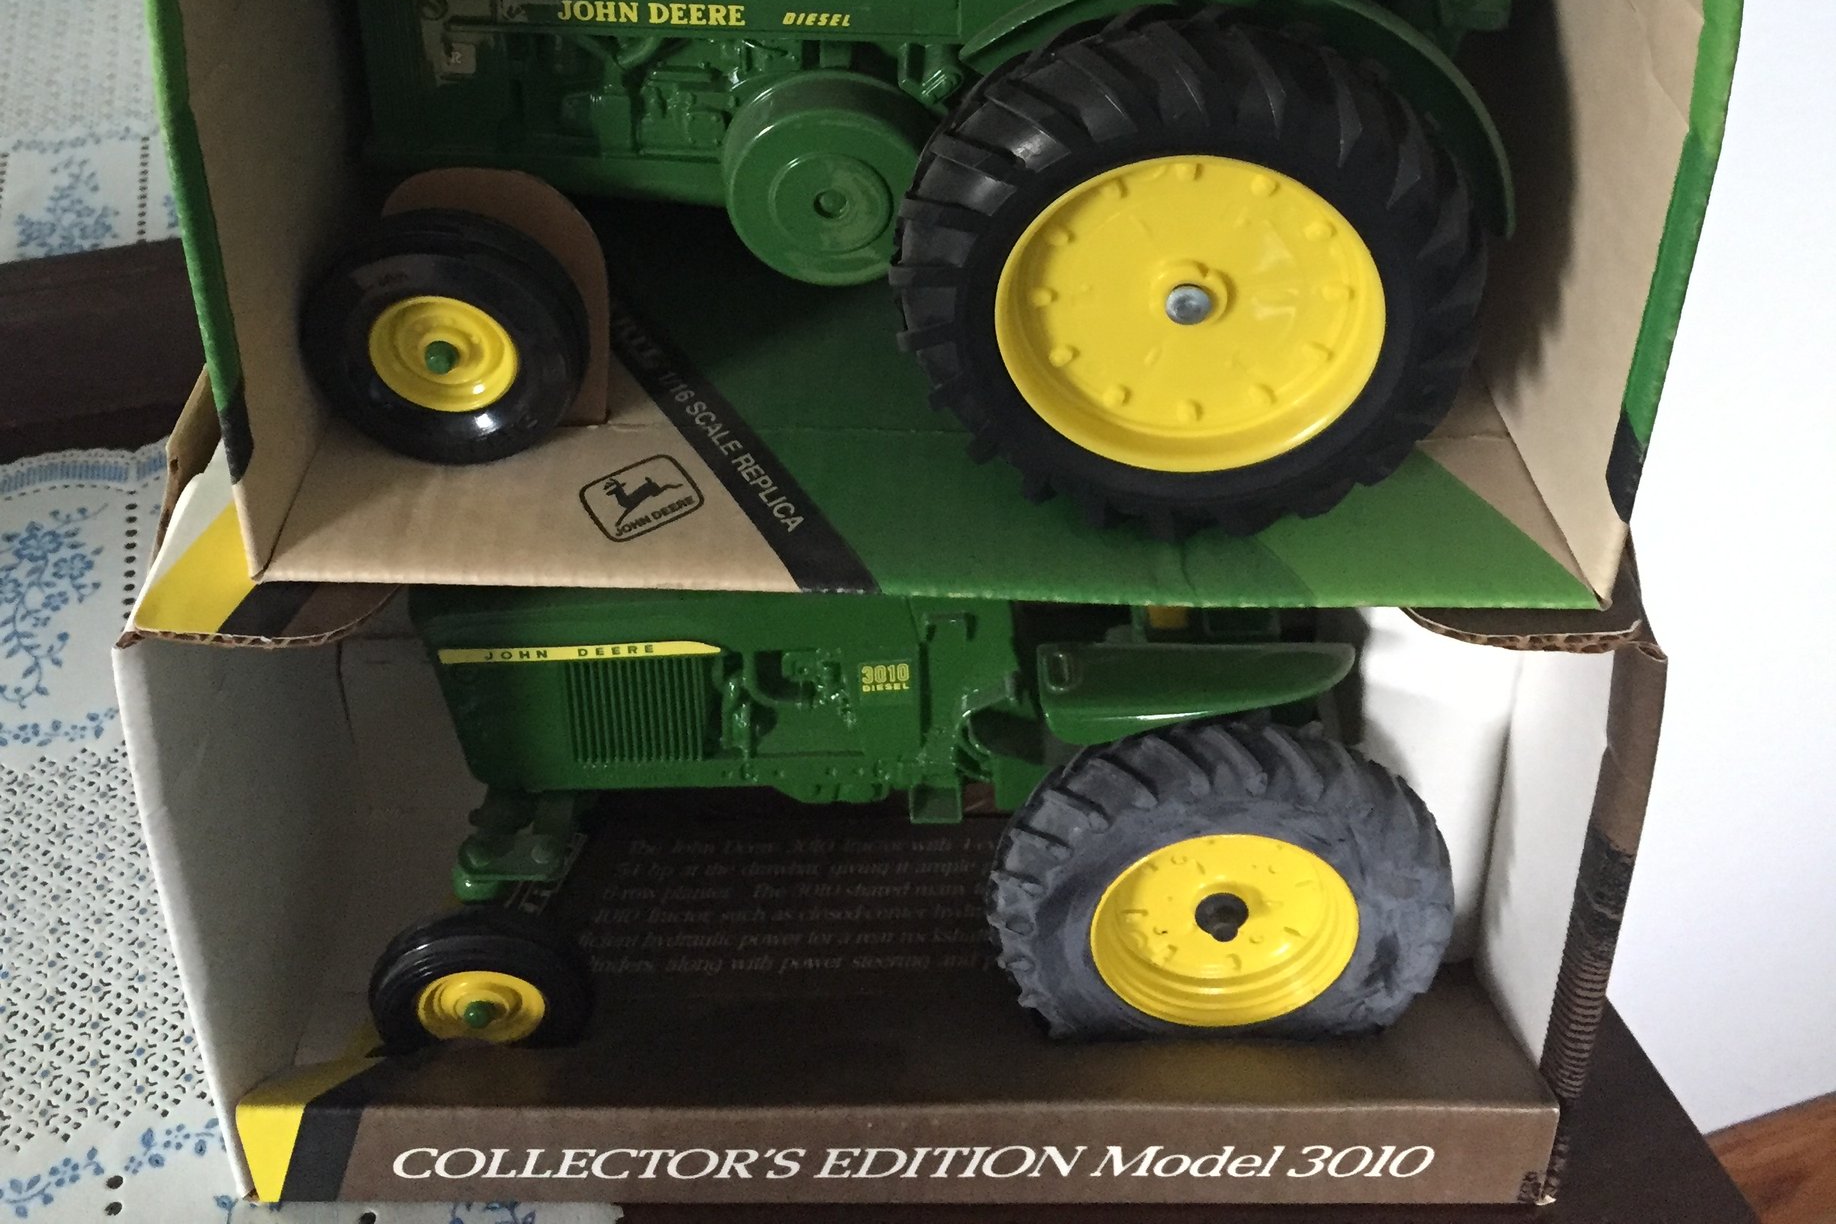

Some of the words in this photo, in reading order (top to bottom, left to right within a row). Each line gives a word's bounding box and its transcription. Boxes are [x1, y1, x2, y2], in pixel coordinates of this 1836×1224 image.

[558, 0, 638, 23] JOHN
[648, 2, 746, 27] DEERE
[782, 11, 851, 27] DIESEL
[658, 370, 695, 402] 1/16
[686, 400, 743, 457] SCALE
[732, 452, 805, 534] REPLICA
[614, 513, 651, 537] JOHN
[652, 495, 698, 521] DEERE
[483, 649, 549, 661] JOHN
[577, 643, 656, 658] DEERE
[860, 663, 910, 686] 3010
[861, 682, 910, 693] DIESEL
[392, 1144, 806, 1180] COLLECTOR'S
[814, 1144, 1087, 1180] EDITION
[1090, 1144, 1283, 1180] Model
[1287, 1144, 1435, 1180] 3010
